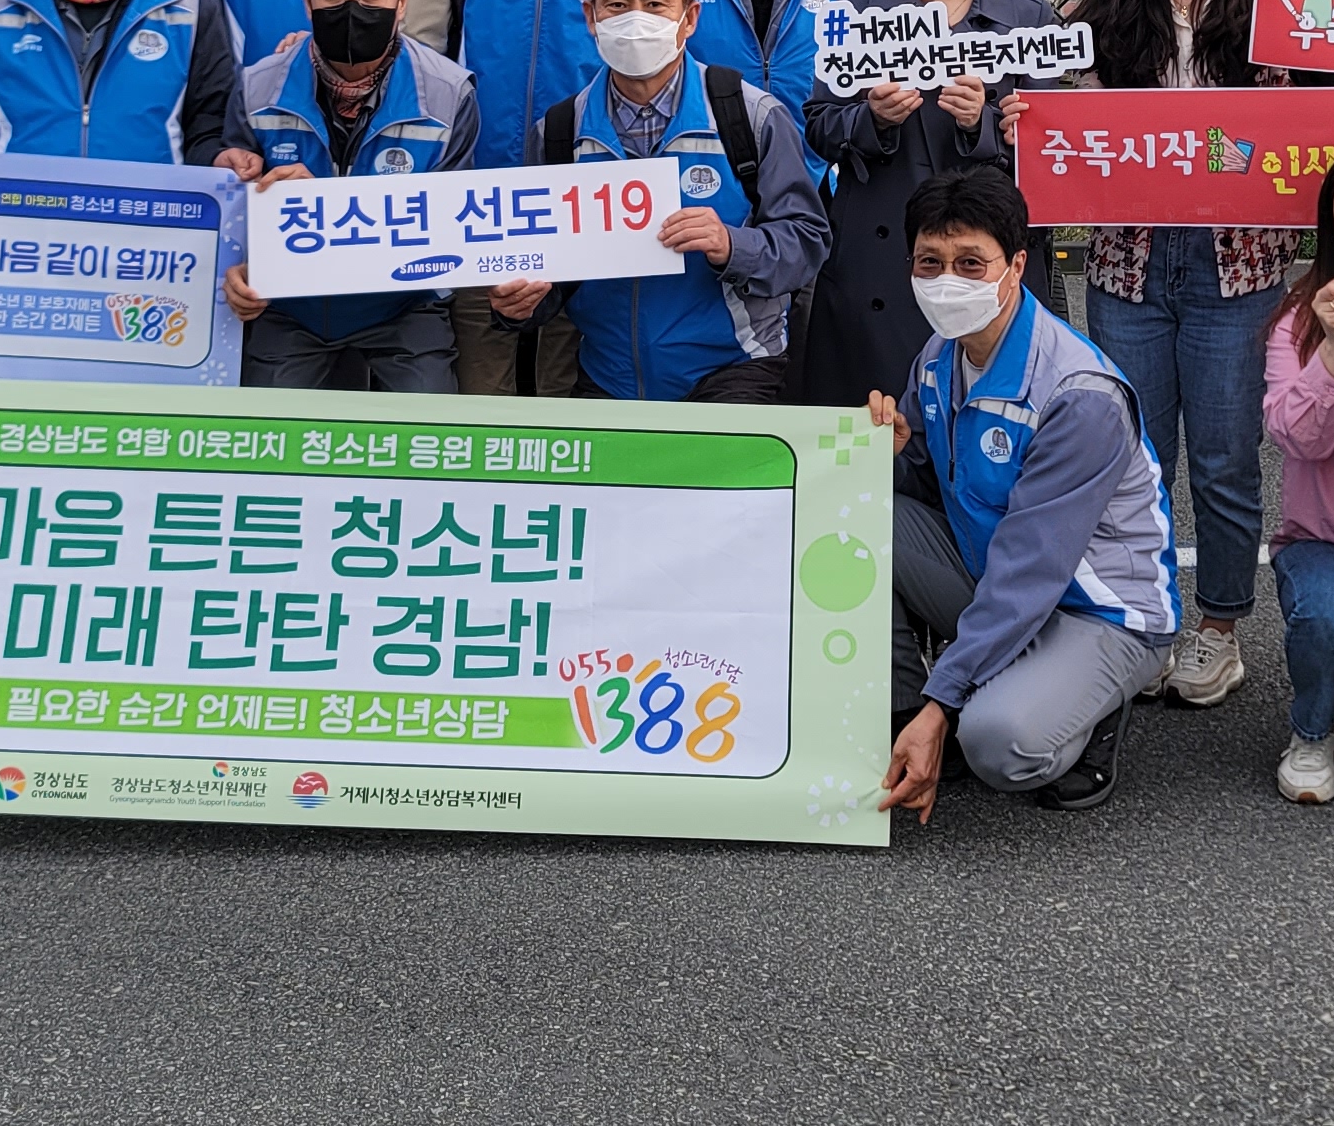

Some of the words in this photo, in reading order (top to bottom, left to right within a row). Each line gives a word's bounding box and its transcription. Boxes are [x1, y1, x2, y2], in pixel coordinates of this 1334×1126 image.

[823, 9, 940, 46] #거제시
[824, 30, 1086, 88] 청소년상담복지센터
[1040, 129, 1203, 176] 중독시작
[0, 192, 22, 206] 연합
[70, 194, 115, 214] 청소년
[118, 197, 148, 216] 응원
[152, 199, 202, 219] 캠페인!
[278, 190, 430, 254] 청소년
[455, 180, 654, 243] 선도119
[46, 242, 108, 278] 같이
[116, 247, 198, 284] 열까?
[400, 260, 456, 274] SAMSUNG
[476, 252, 544, 273] 삼성중공업
[23, 295, 36, 309] 및
[39, 295, 103, 313] 보호자에겐
[11, 310, 47, 330] 순간
[50, 312, 102, 333] 언제든
[113, 305, 189, 346] 1388
[0, 423, 108, 456] 경상남도
[115, 427, 171, 458] 연합
[178, 429, 286, 462] 아웃리치
[301, 430, 398, 469] 청소년
[408, 435, 472, 471] 응원
[484, 436, 592, 474] 캠페인!
[147, 492, 304, 574] 튼튼
[331, 496, 588, 583] 청소년!
[3, 583, 164, 666] 미래
[187, 589, 350, 672] 탄탄
[372, 594, 552, 679] 경남!
[559, 649, 612, 681] 055
[665, 647, 743, 685] 청소년상담
[6, 687, 109, 726] 필요한
[117, 691, 188, 728] 순간
[195, 694, 307, 732] 언제든!
[318, 694, 509, 741] 청소년상담
[573, 672, 742, 764] 1388
[33, 771, 89, 789] 경상남도
[111, 777, 267, 798] 경상남도청소년지원재단
[232, 765, 267, 777] 경상남도
[31, 789, 88, 801] GYEONGNAM
[178, 796, 197, 805] Youth
[198, 798, 226, 808] Support
[227, 799, 266, 808] Foundation
[339, 784, 522, 810] 거제시청소년상담복지센터
